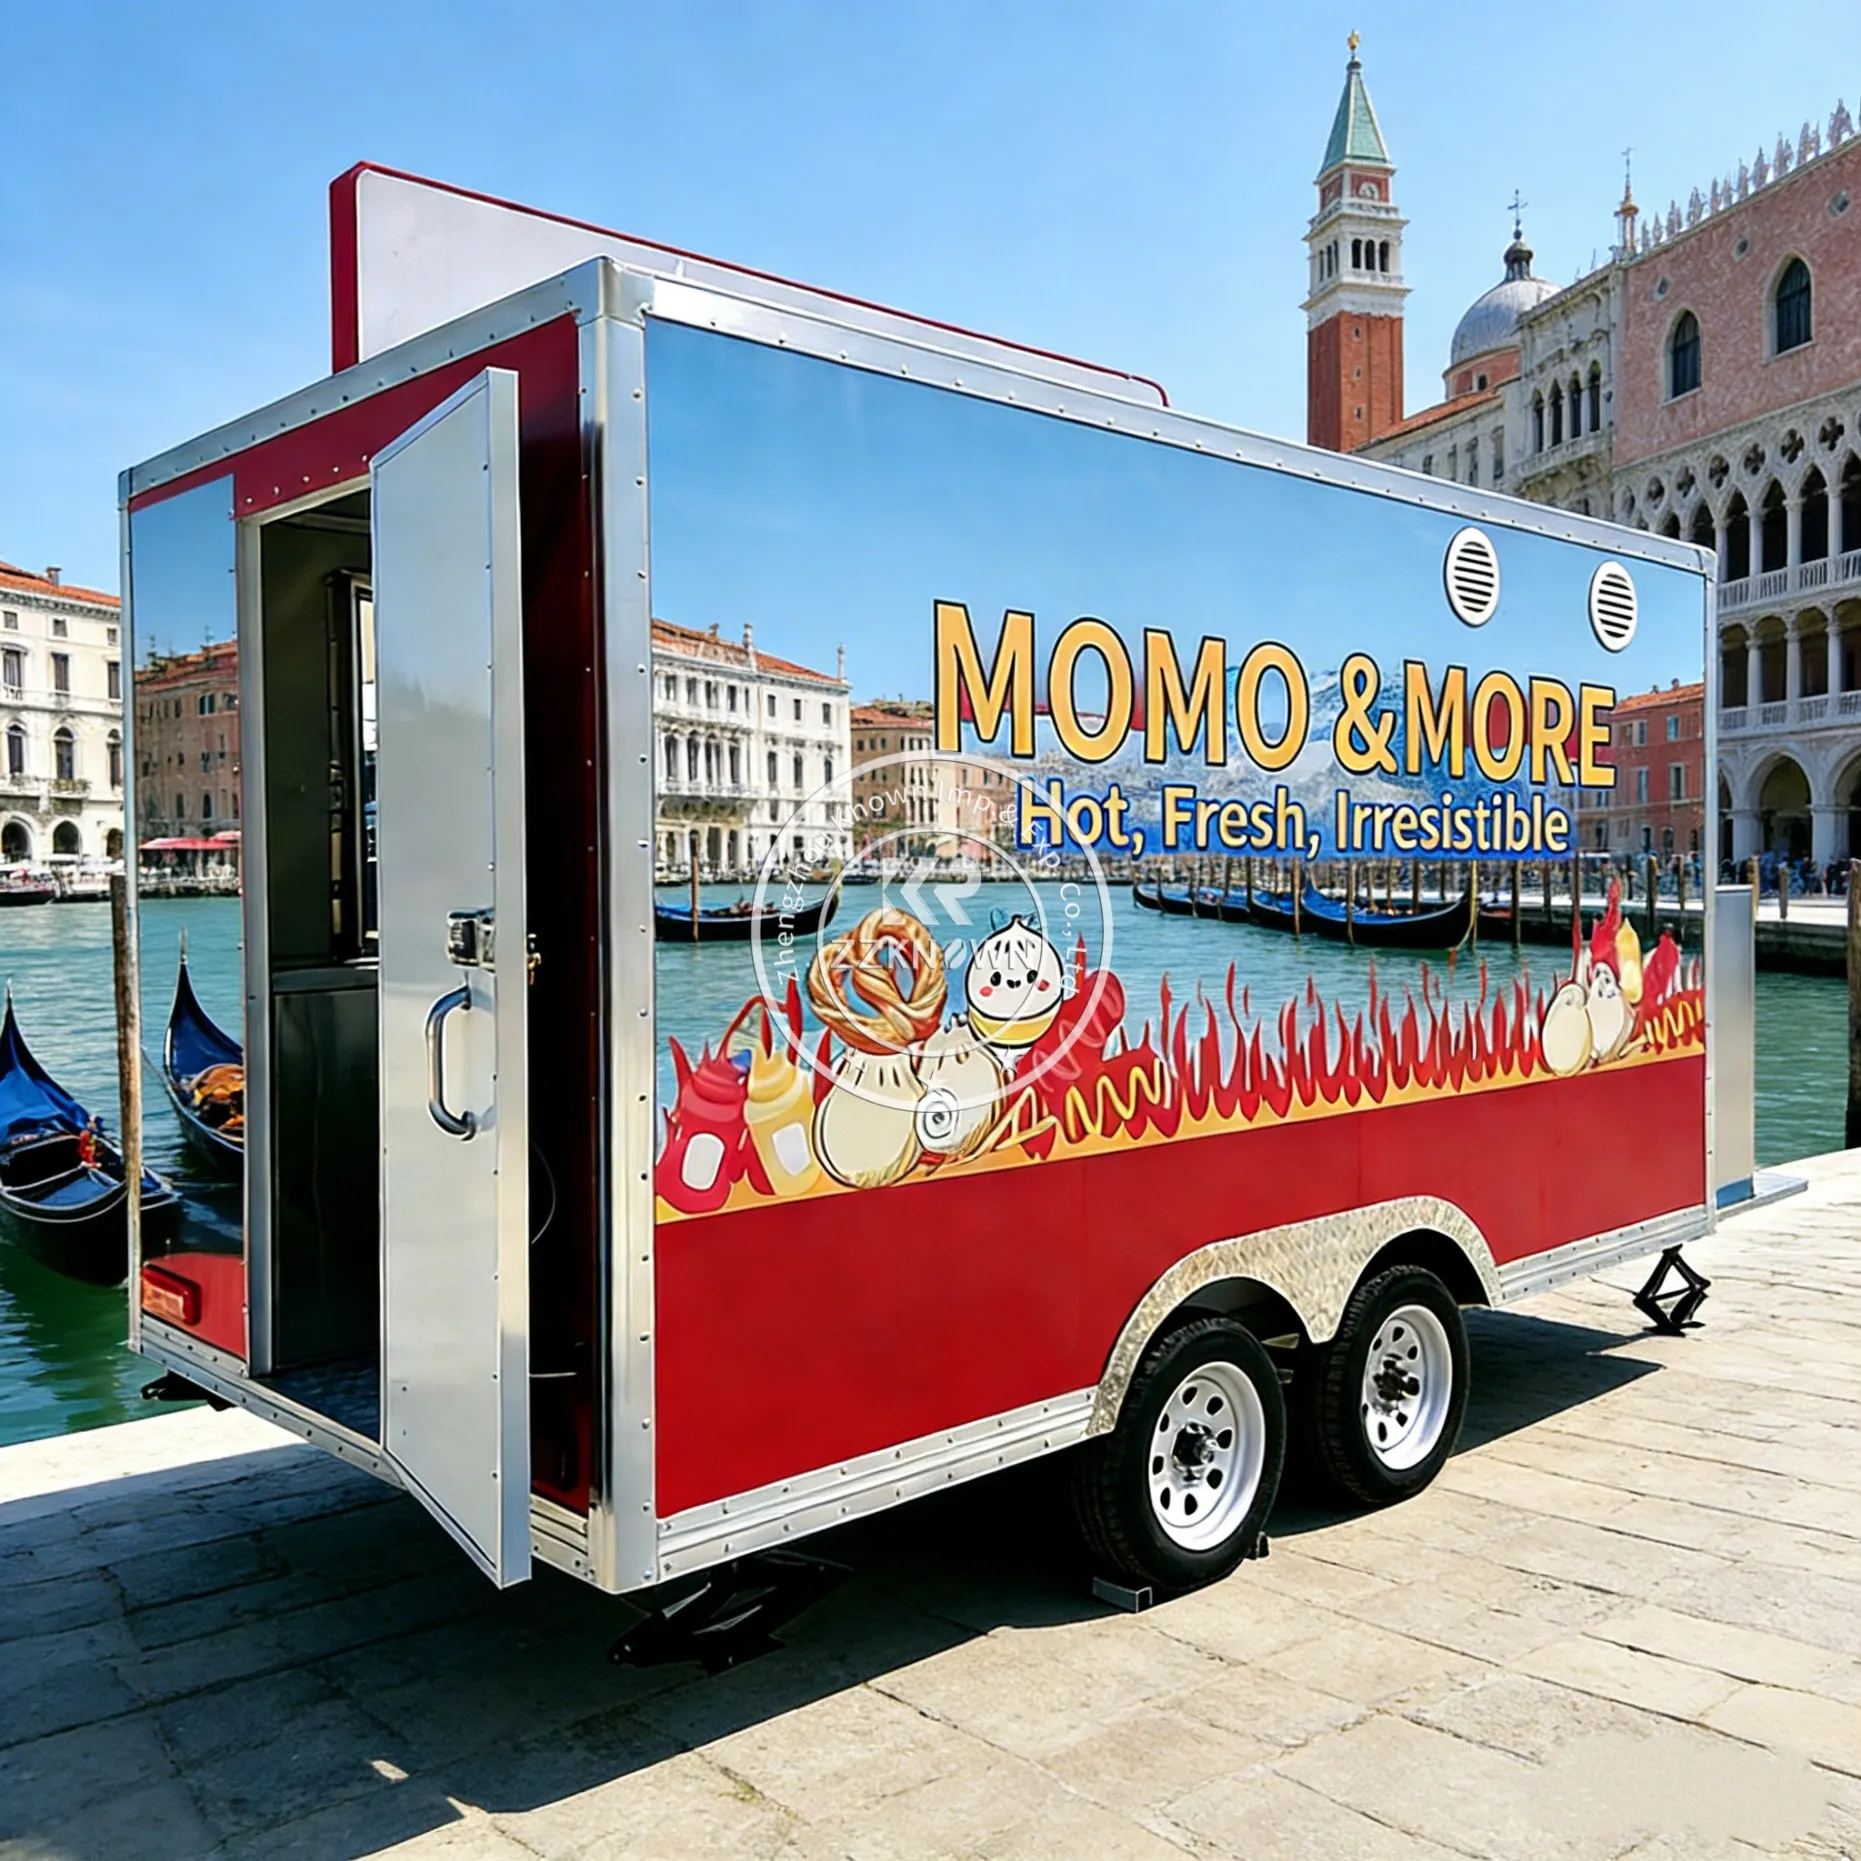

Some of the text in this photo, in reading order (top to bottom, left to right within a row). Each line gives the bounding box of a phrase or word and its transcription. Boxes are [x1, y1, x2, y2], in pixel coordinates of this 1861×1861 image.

[934, 600, 1310, 772] MOMO
[1017, 775, 1572, 861] Hot, Fresh, Irresistible
